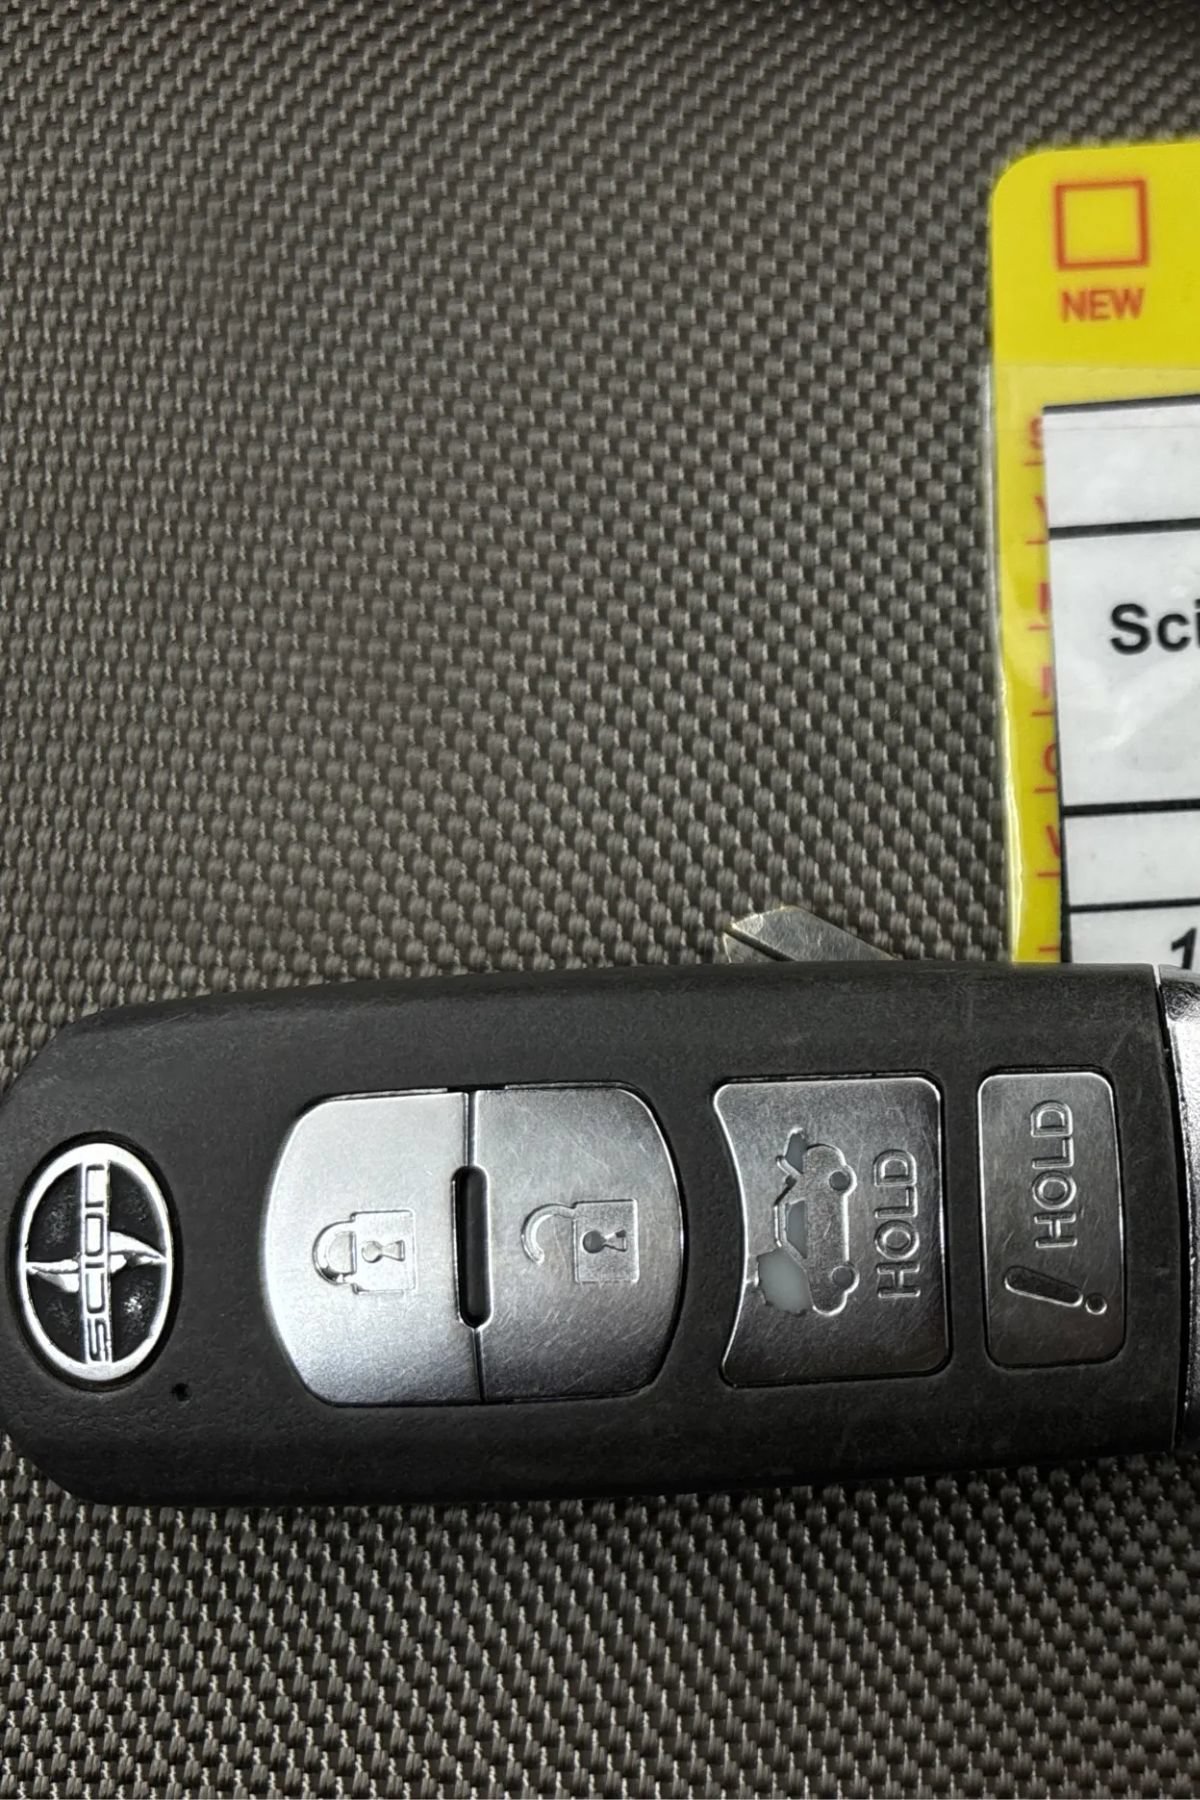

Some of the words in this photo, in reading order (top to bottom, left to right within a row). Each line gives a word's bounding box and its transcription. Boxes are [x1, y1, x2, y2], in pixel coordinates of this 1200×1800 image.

[1060, 288, 1145, 323] NEW
[872, 1148, 922, 1300] HOLD
[1029, 1099, 1078, 1250] HOLD
[80, 1162, 113, 1364] SCION
